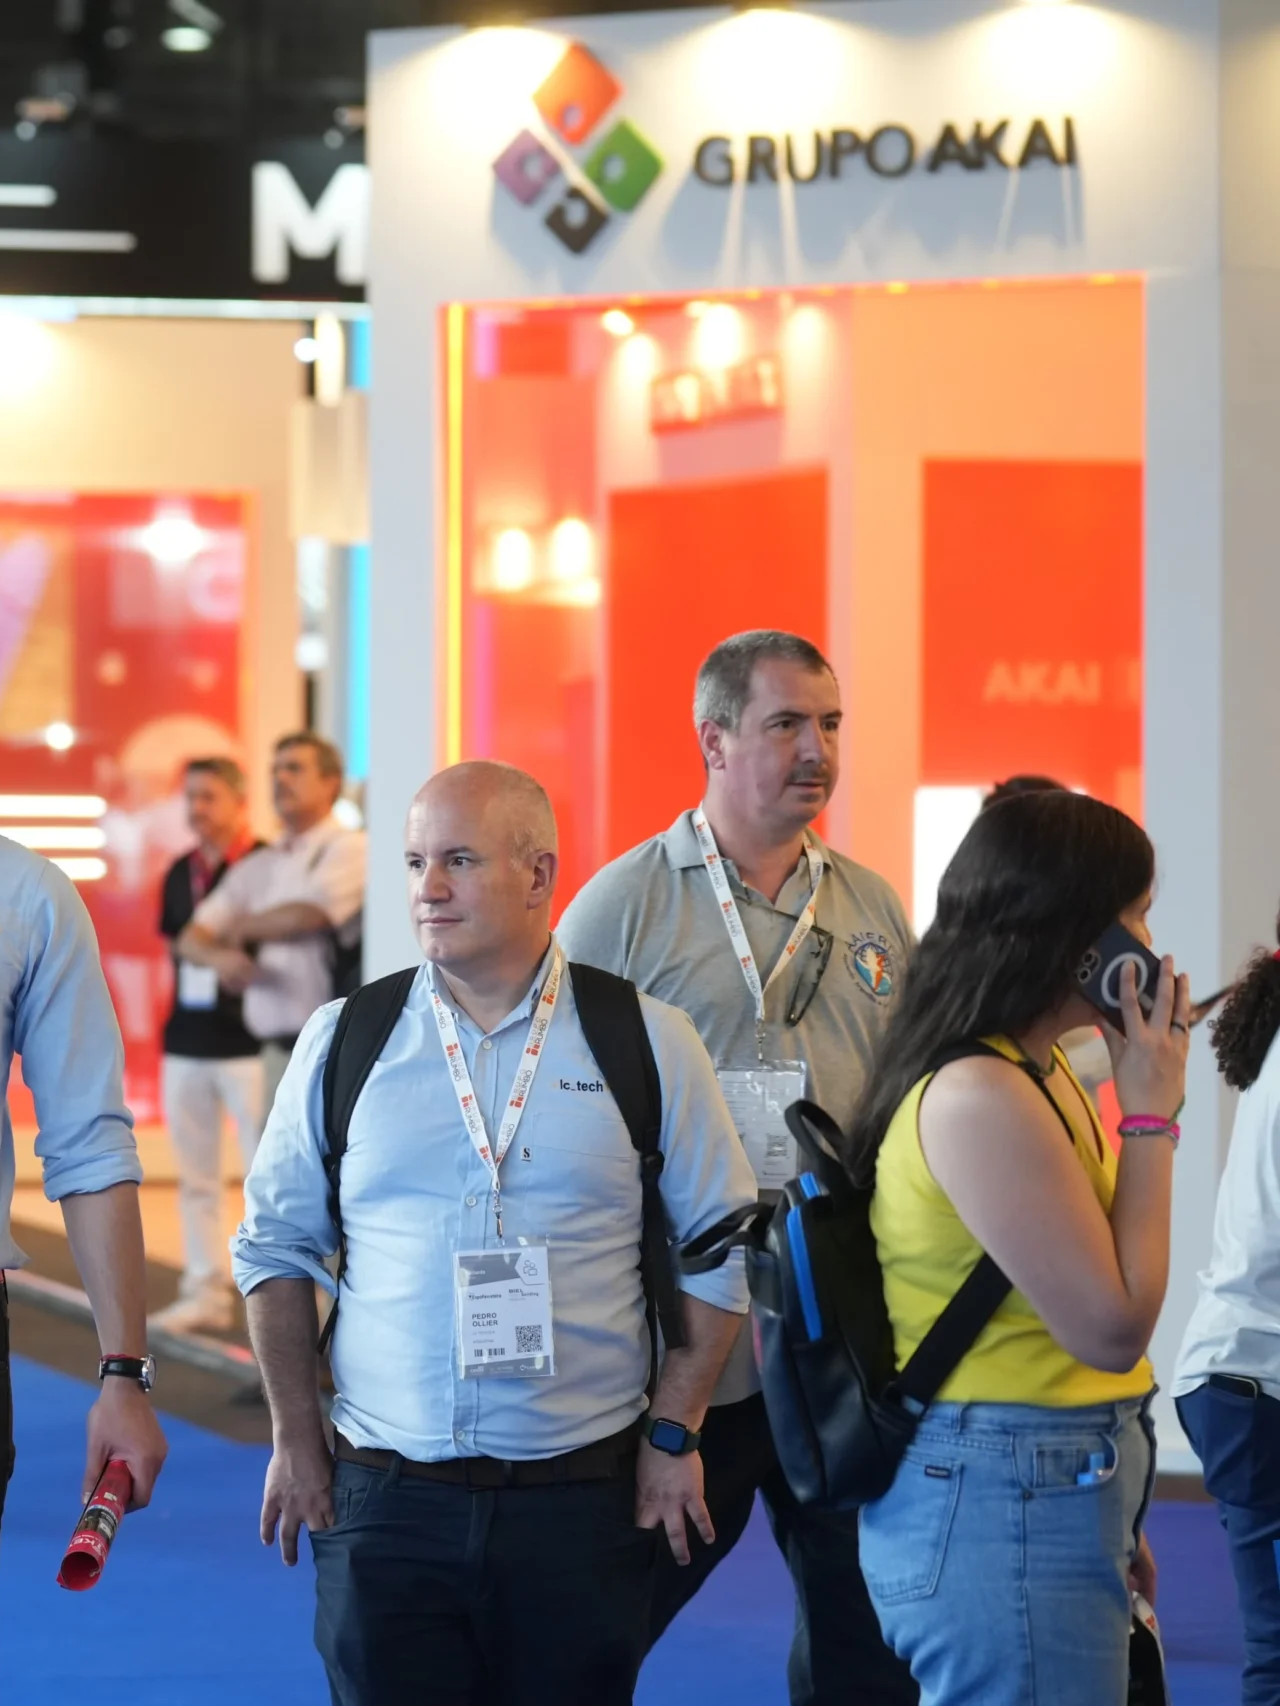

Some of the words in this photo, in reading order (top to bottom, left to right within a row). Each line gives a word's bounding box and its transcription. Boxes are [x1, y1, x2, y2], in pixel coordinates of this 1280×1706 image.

[694, 122, 918, 187] GRUPO
[925, 115, 1076, 173] AKAI
[535, 1018, 548, 1045] RUMBO
[450, 1055, 461, 1082] RUMBO
[520, 1069, 533, 1097] RUMBO
[465, 1107, 477, 1134] RUMBO
[523, 1147, 531, 1158] S
[471, 1312, 497, 1320] PEDRO
[472, 1319, 498, 1327] OLLIER
